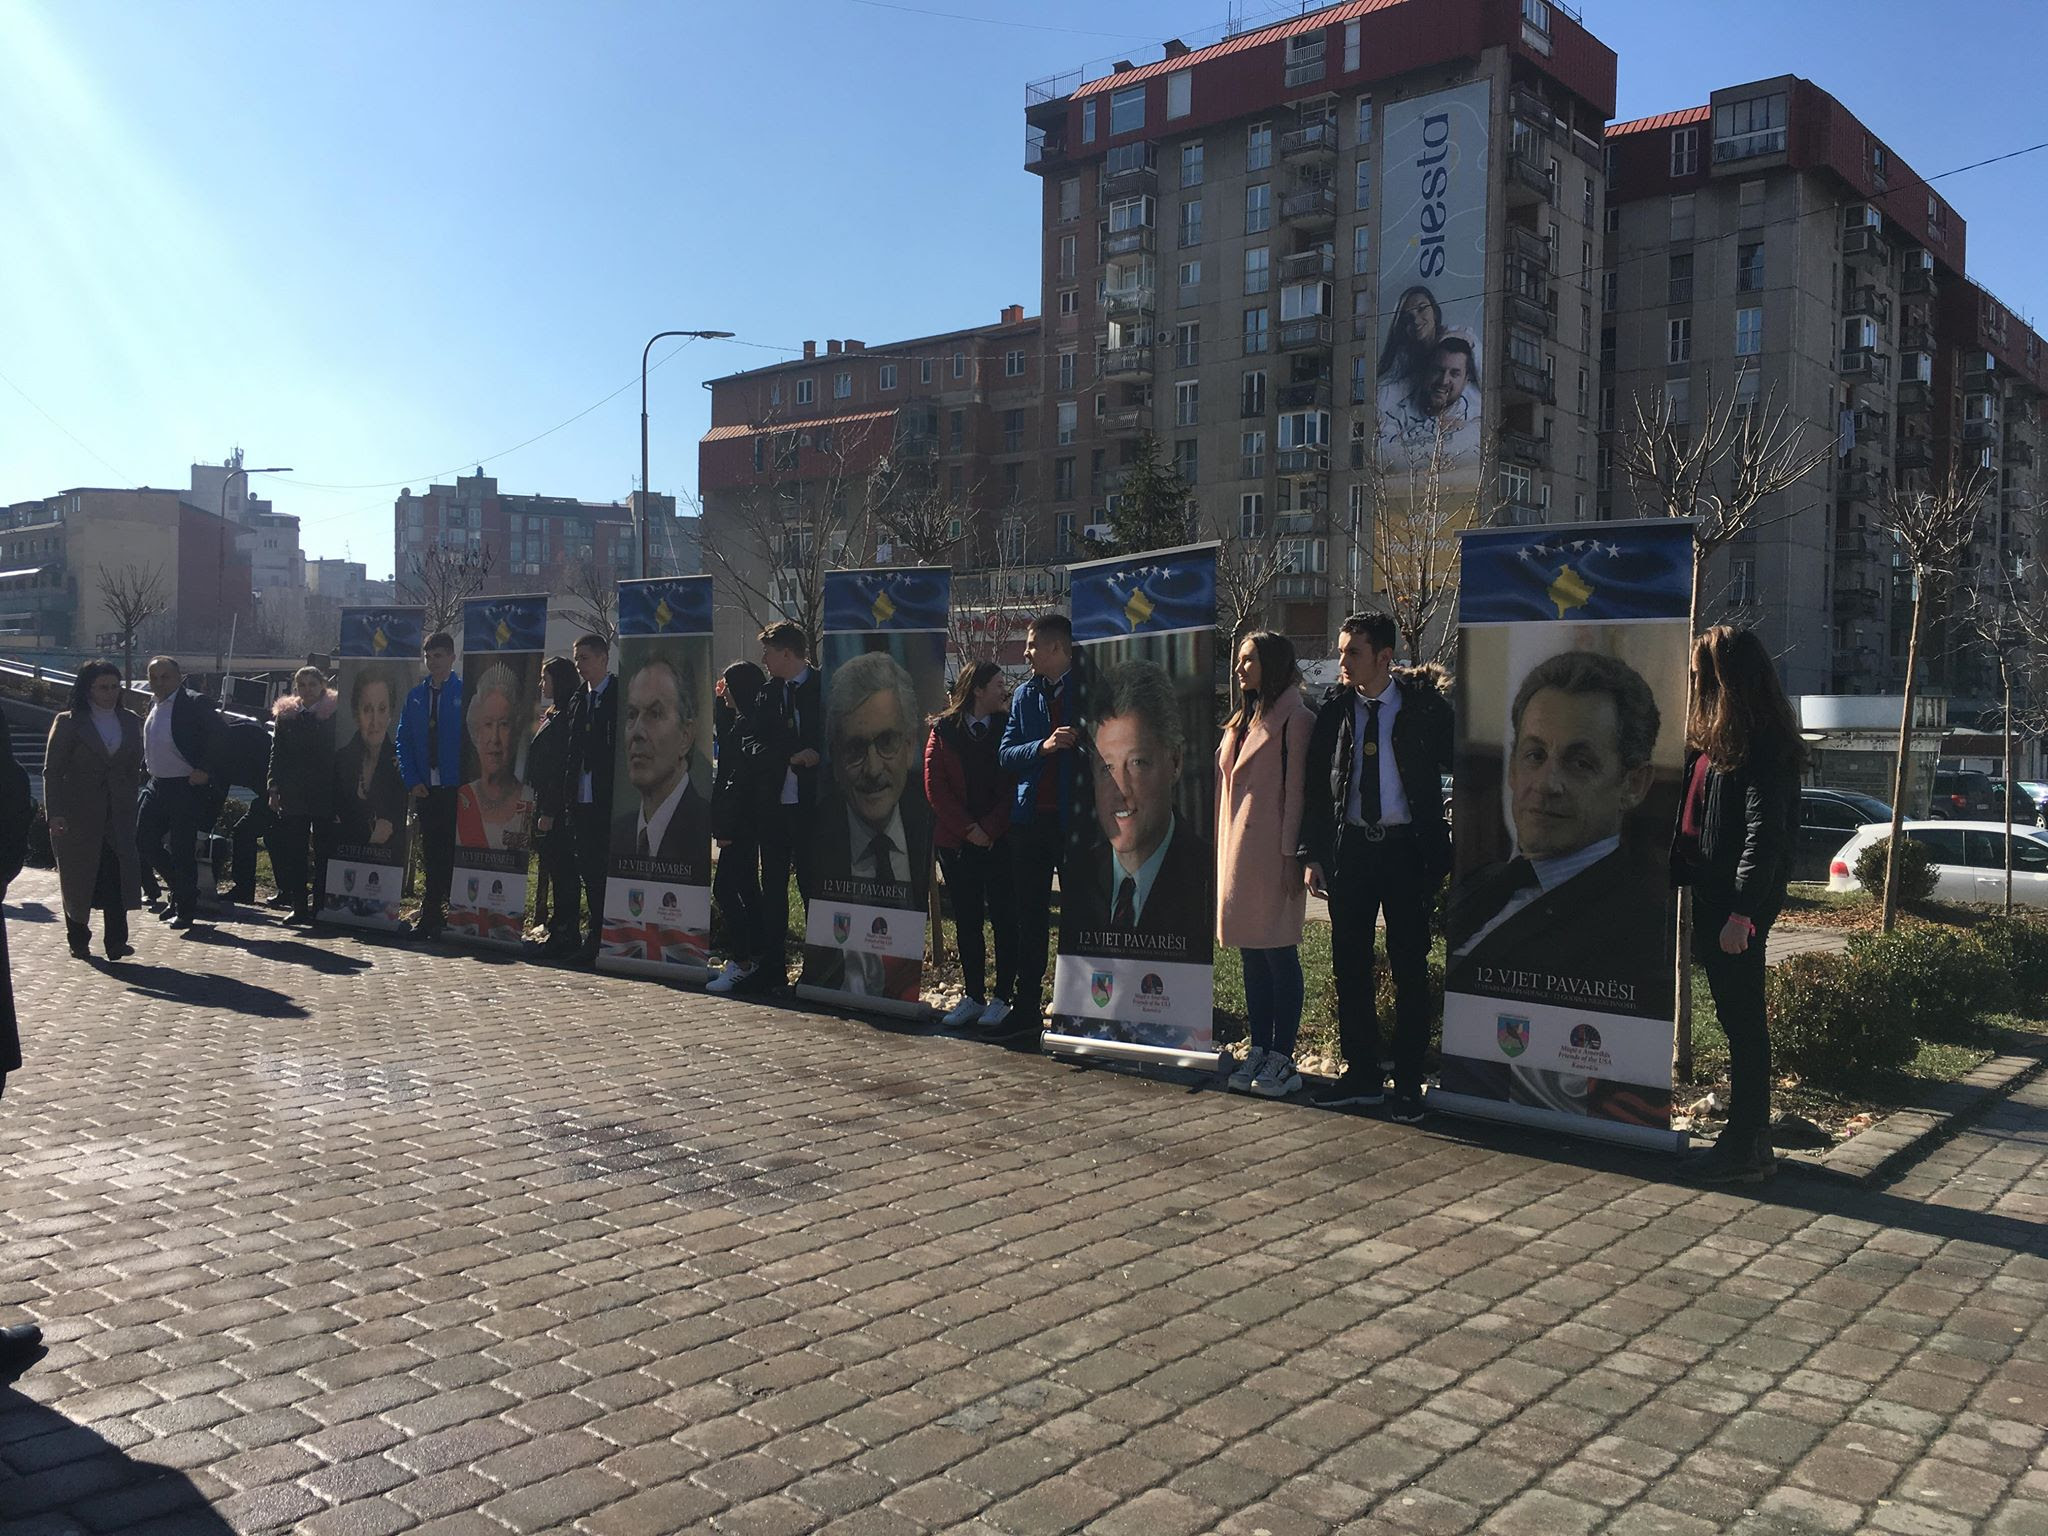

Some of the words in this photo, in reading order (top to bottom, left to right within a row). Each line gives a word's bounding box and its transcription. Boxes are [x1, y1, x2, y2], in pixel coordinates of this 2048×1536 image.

[1417, 112, 1450, 279] siesta
[823, 879, 833, 891] 12
[835, 880, 858, 894] VJET
[1079, 931, 1090, 945] 12
[1093, 932, 1121, 947] VJET
[1124, 933, 1187, 951] PAVARËSI
[1476, 967, 1493, 983] 12
[1498, 969, 1543, 990] VJET
[1546, 975, 1637, 1001] PAVARËSI
